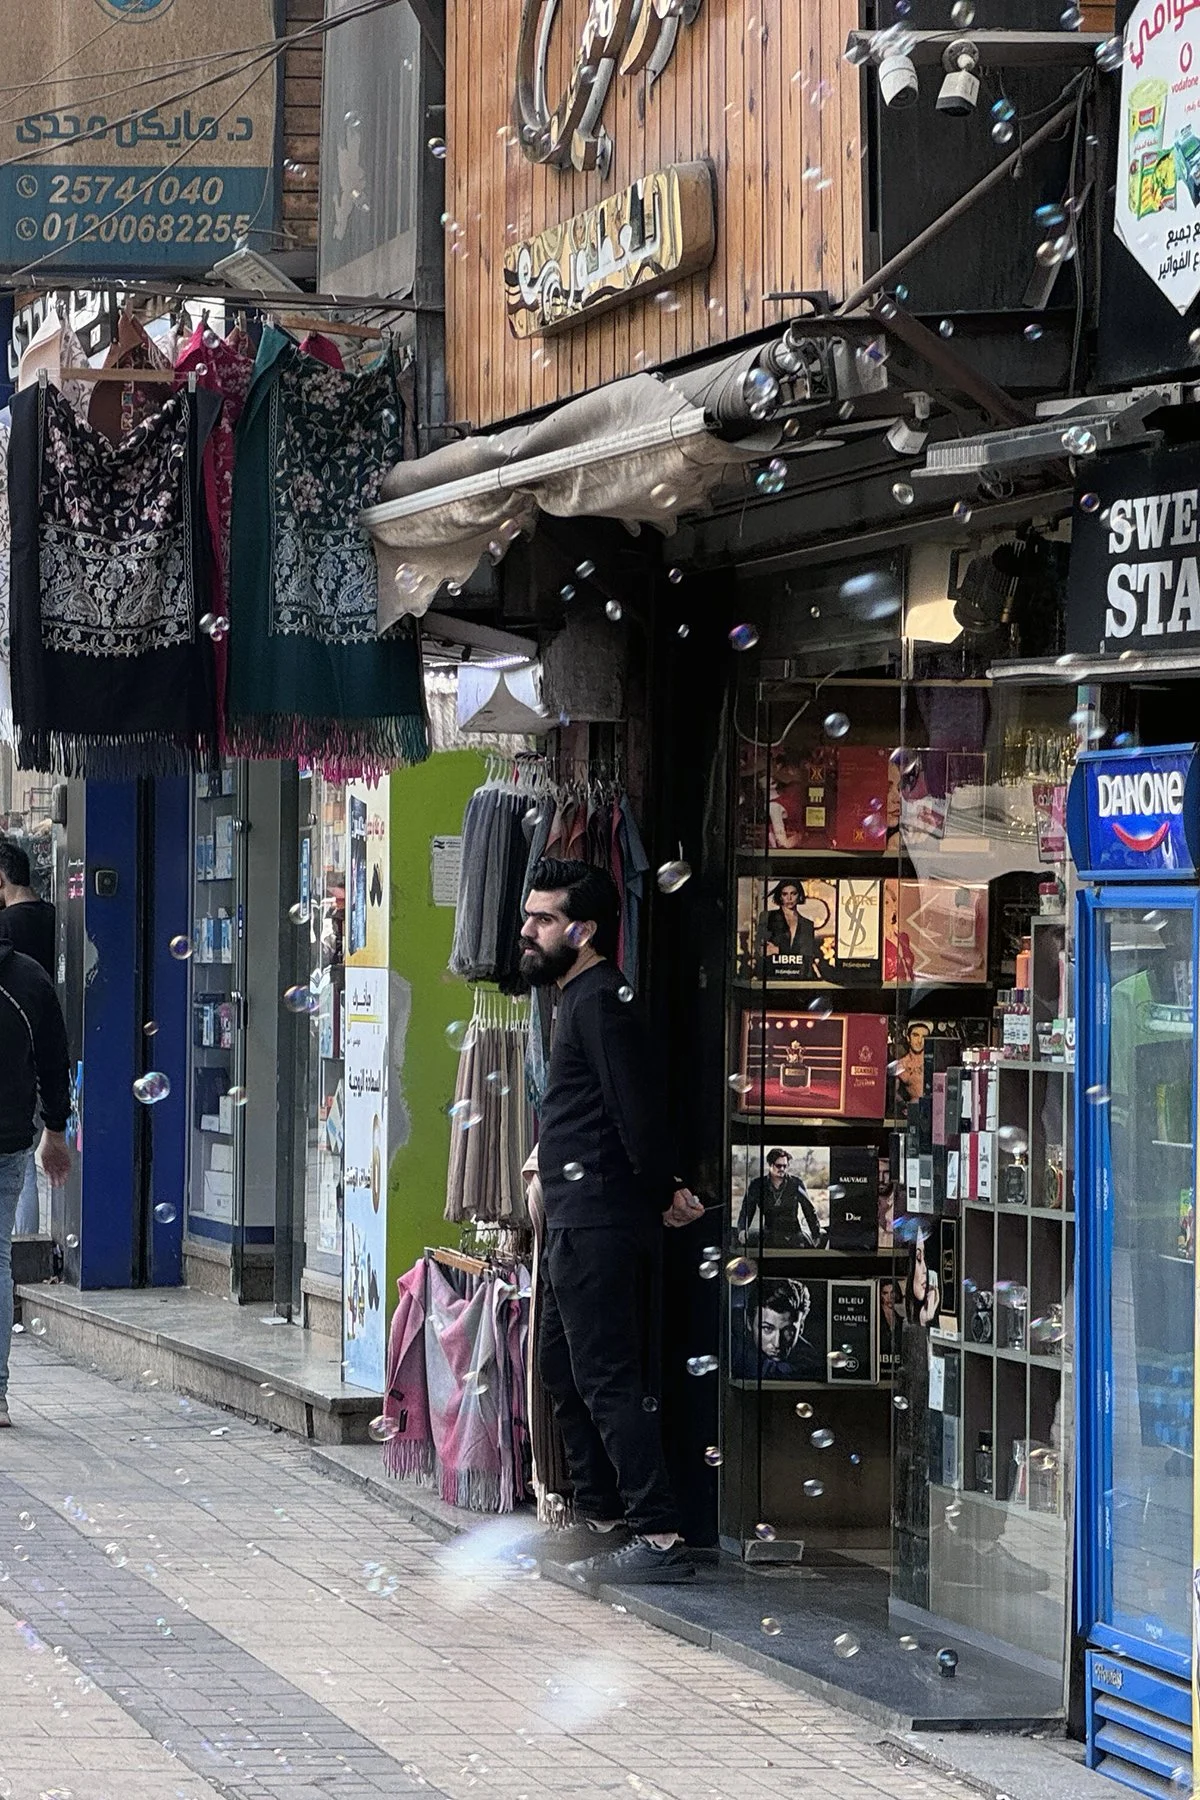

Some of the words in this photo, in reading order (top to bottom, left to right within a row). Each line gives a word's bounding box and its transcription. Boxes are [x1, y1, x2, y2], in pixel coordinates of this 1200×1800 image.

[1171, 75, 1199, 94] vodafone
[115, 109, 218, 148] مايكل
[49, 174, 225, 206] 25741040
[42, 212, 251, 244] 01200682255
[1166, 223, 1191, 250] جميع
[1157, 250, 1191, 281] الفواتير
[1108, 488, 1200, 554] SWE
[1104, 556, 1200, 639] STA
[772, 955, 804, 965] LIBRE
[839, 1176, 868, 1184] SAUVAGE
[845, 1212, 862, 1222] Dior
[838, 1297, 864, 1305] BLEU
[833, 1314, 868, 1322] CHANEL
